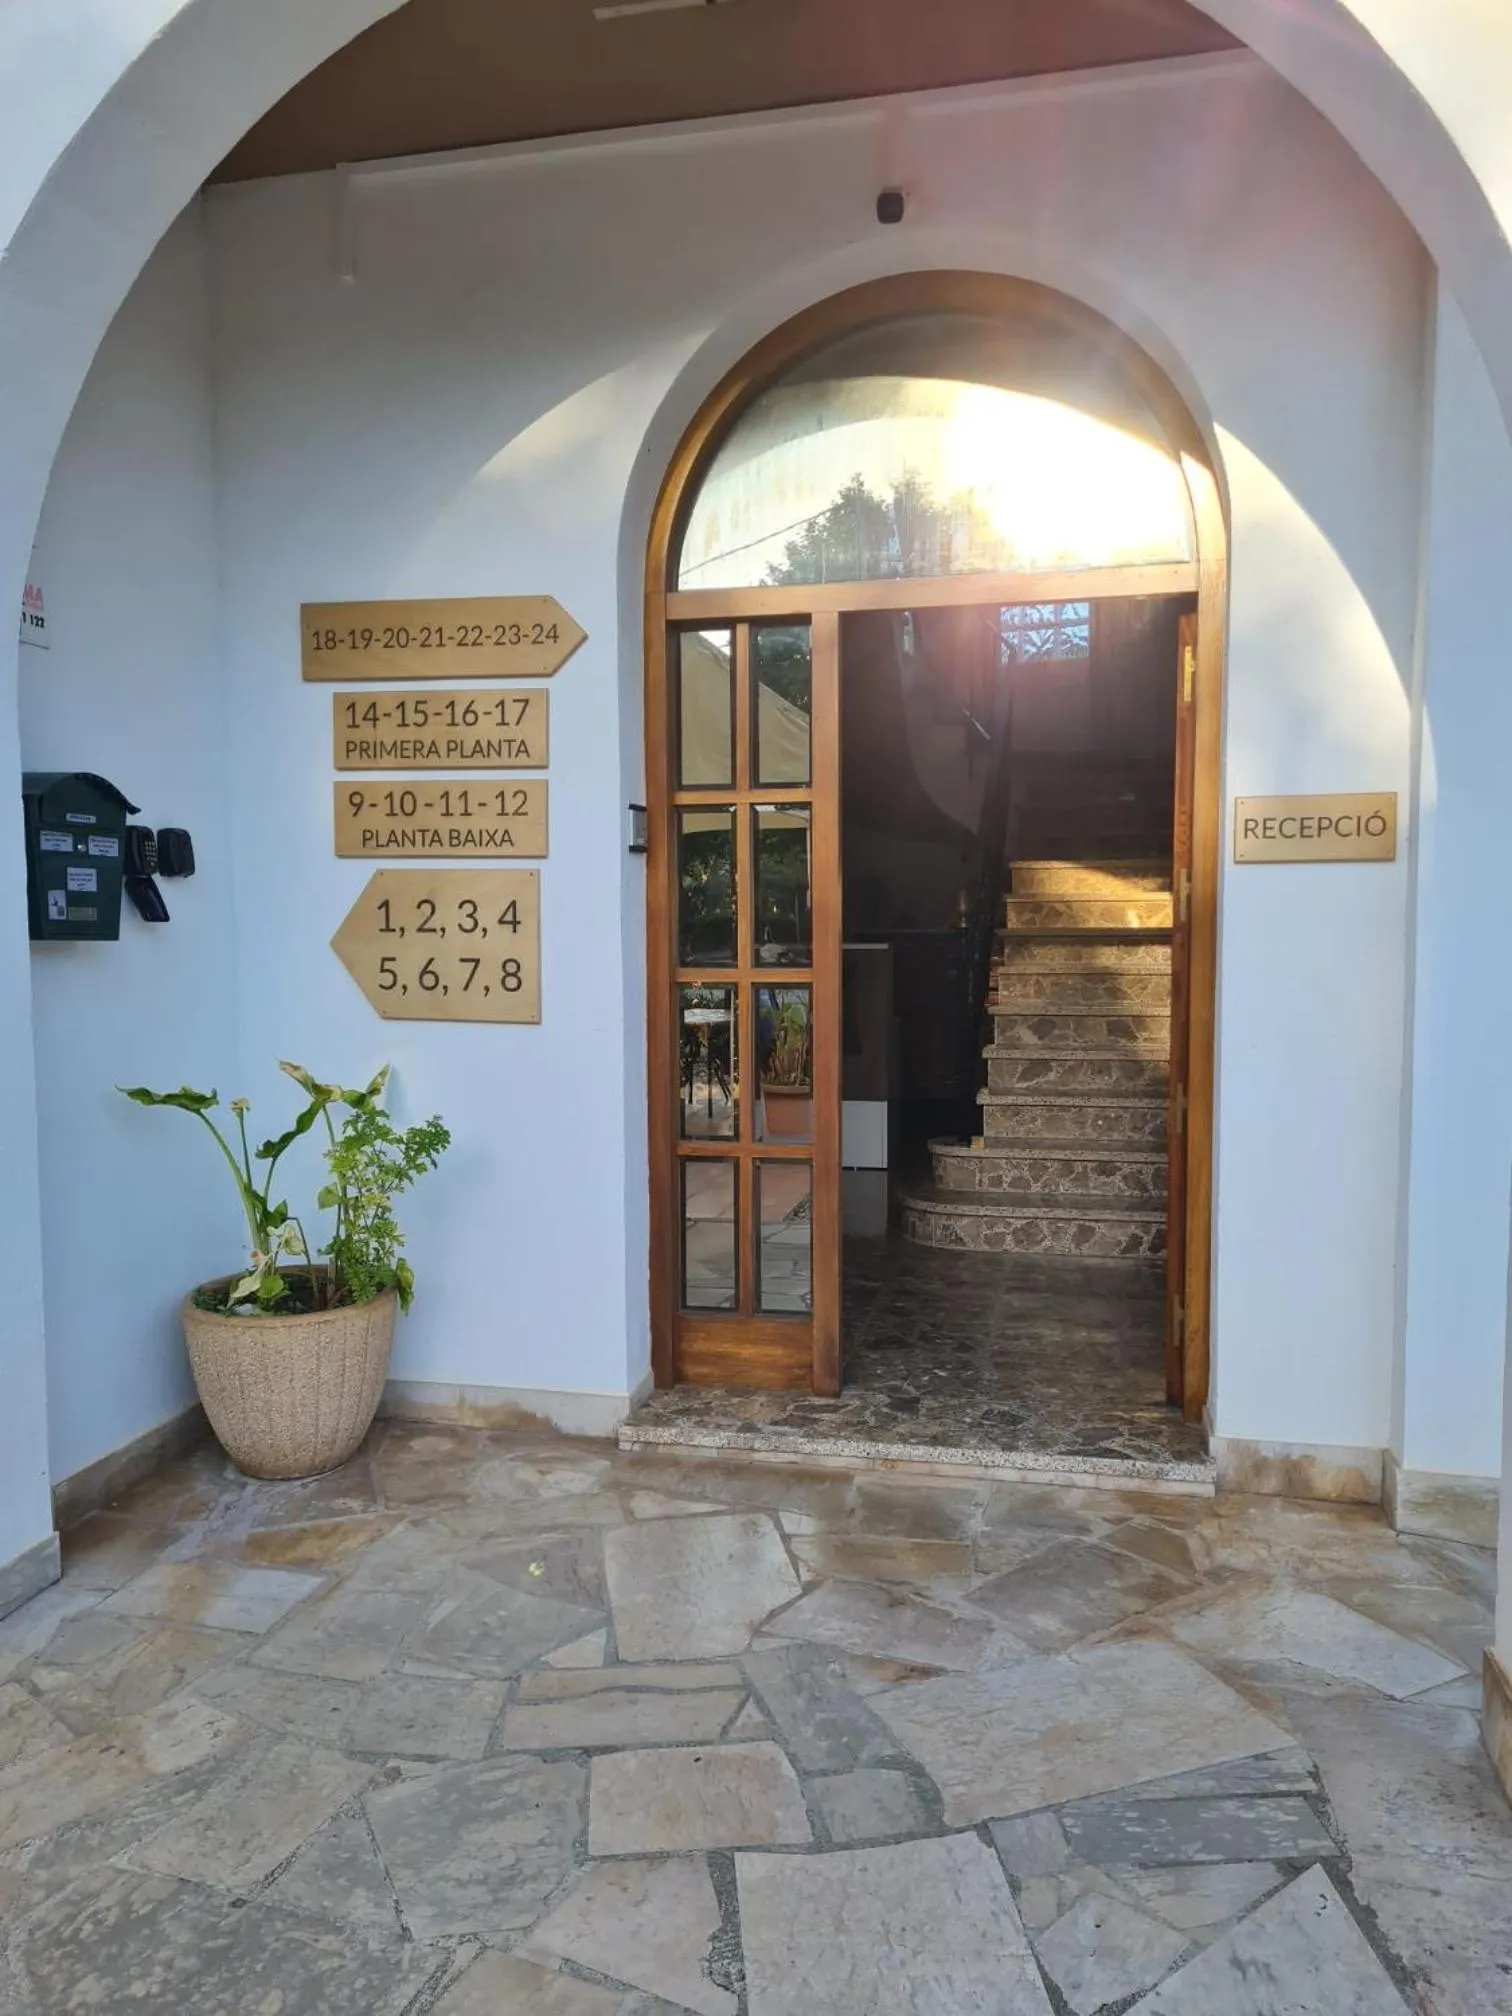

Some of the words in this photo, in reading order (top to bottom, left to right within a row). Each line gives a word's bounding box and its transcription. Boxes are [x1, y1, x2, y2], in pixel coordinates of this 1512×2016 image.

[311, 622, 560, 652] 18-19-20-21-22-23-24
[345, 698, 530, 729] 14-15-16-17
[345, 739, 442, 760] PRIMERA
[446, 739, 530, 759] PLANTA
[361, 828, 444, 849] PLANTA
[448, 828, 515, 848] BAIXA
[1243, 810, 1388, 840] RECEPCIÓ
